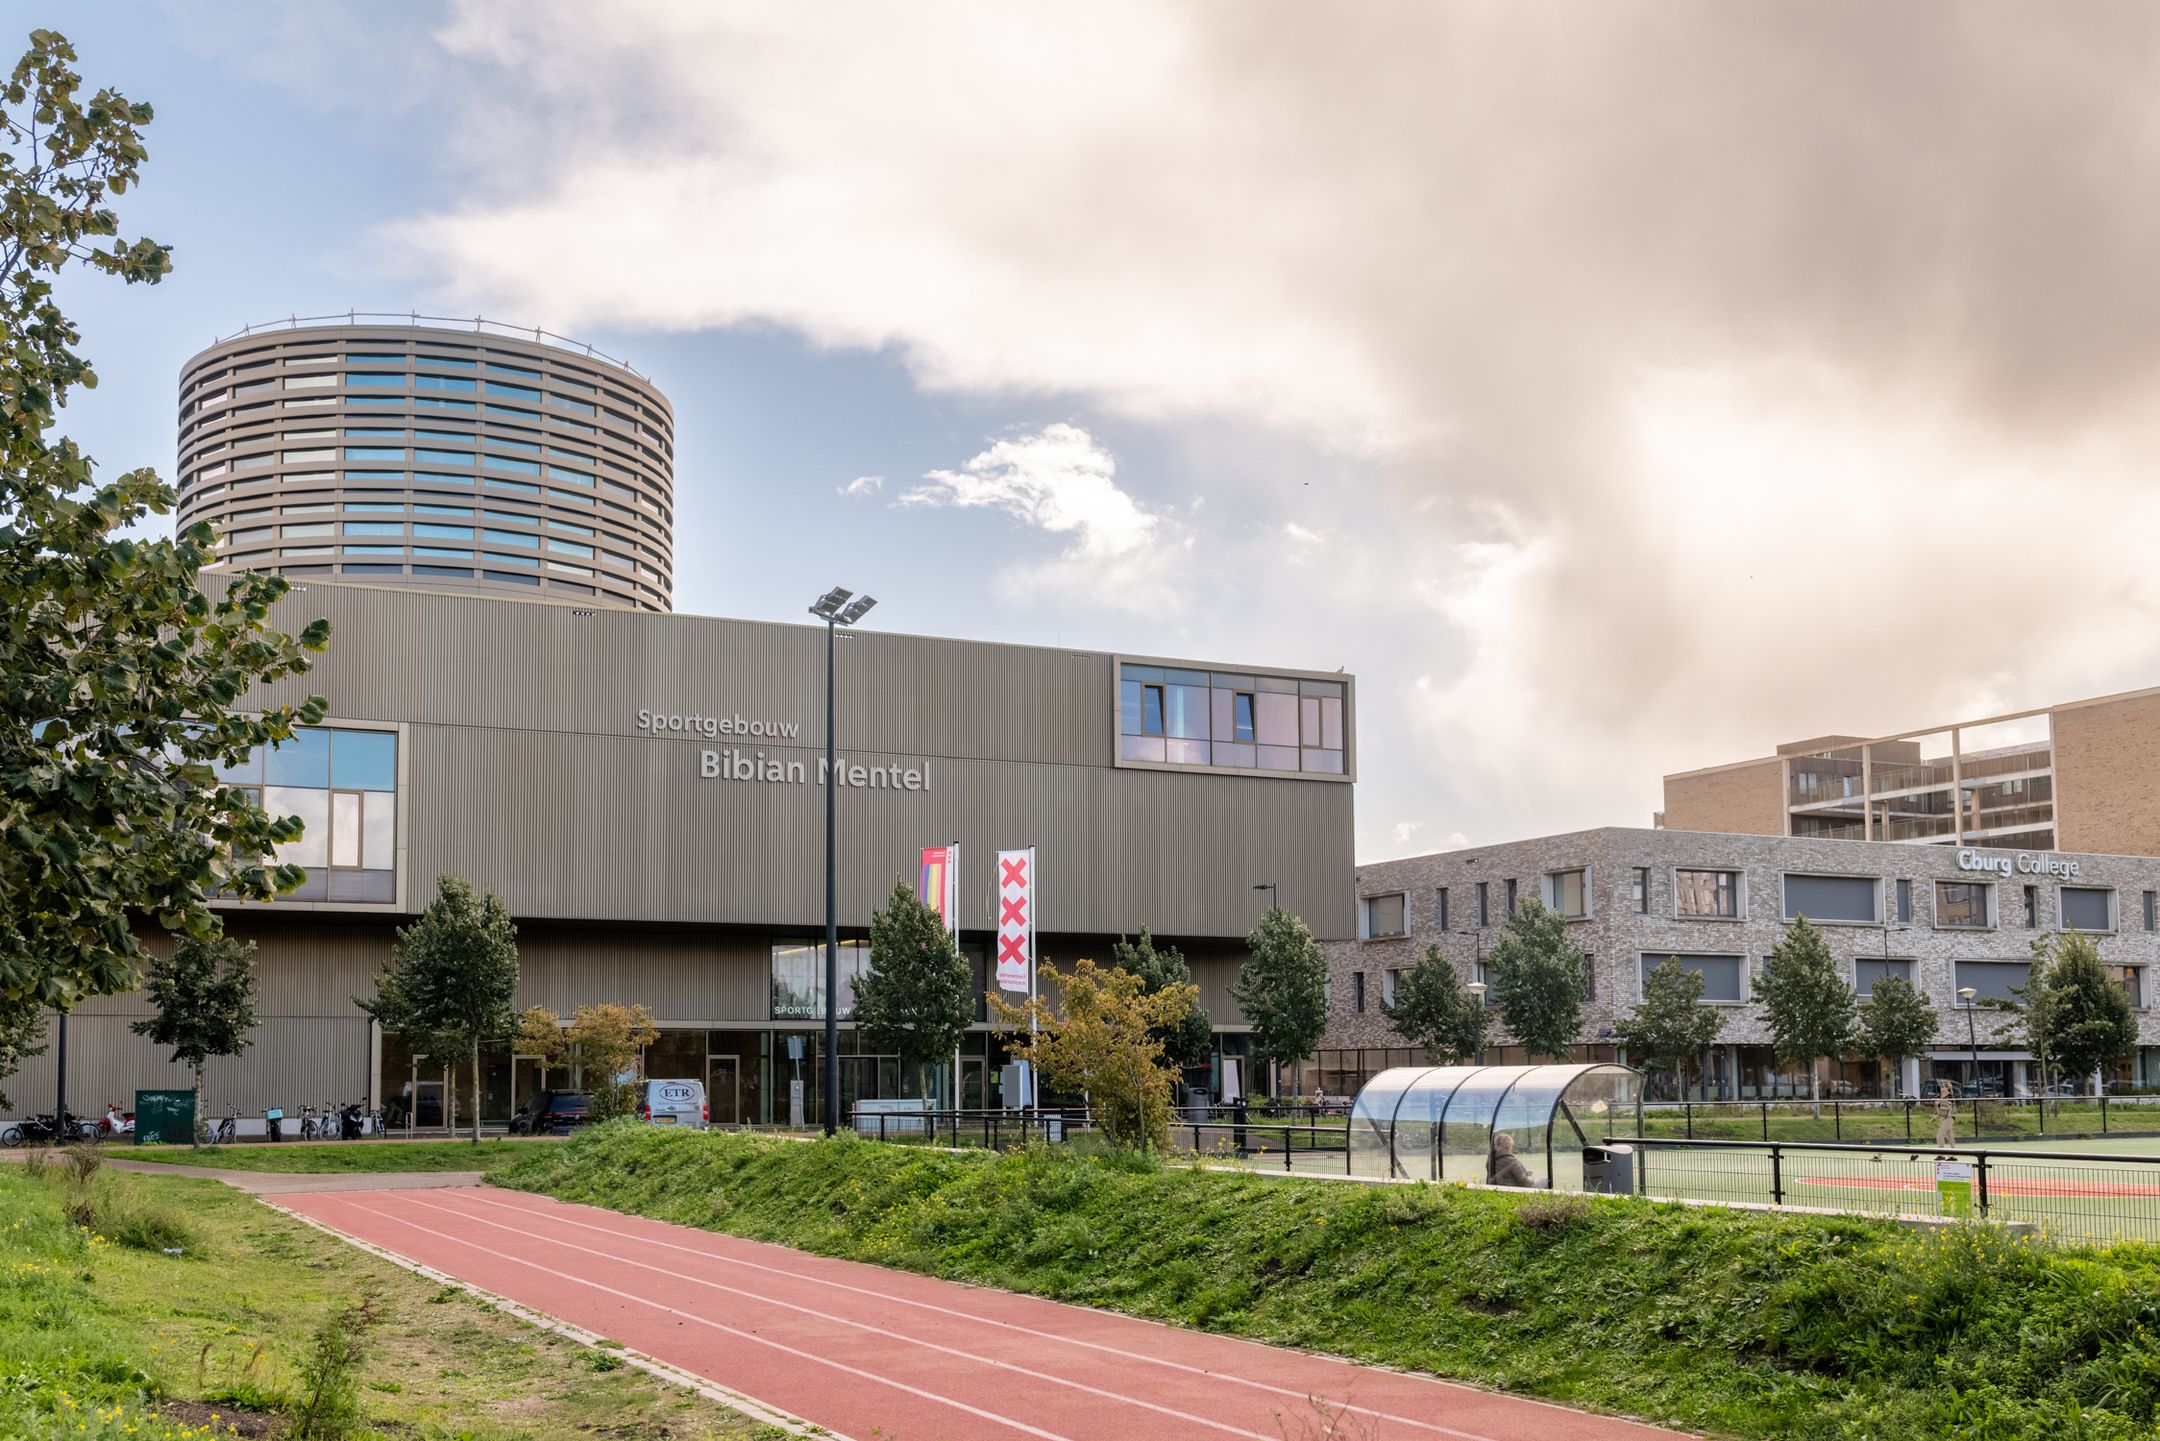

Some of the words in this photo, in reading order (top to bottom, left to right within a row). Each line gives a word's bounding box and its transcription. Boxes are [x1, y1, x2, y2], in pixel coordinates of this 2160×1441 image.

[636, 709, 799, 738] Sportgebouw
[700, 750, 805, 784] Bibian
[818, 757, 930, 791] Mentel
[2016, 853, 2079, 880] College
[774, 1006, 851, 1015] SPORTGEBUW
[664, 1088, 690, 1097] ETR
